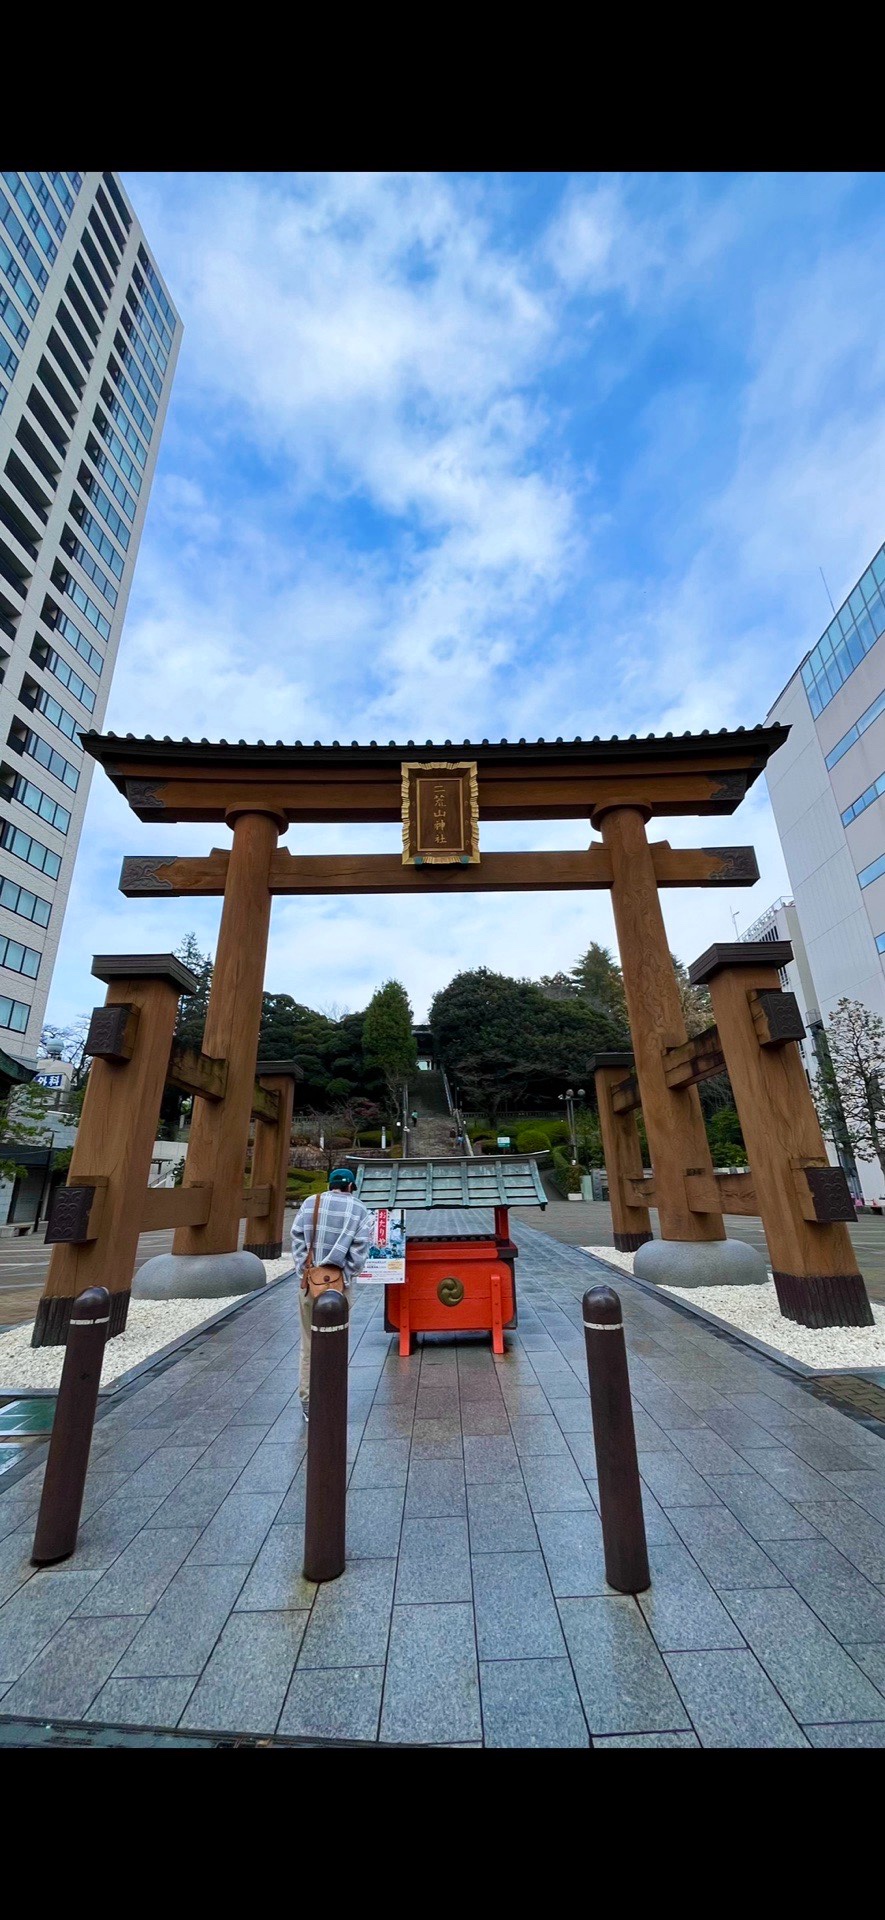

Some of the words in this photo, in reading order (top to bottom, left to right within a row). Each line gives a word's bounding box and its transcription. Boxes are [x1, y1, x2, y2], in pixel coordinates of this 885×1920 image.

[433, 785, 447, 844] 二荒山神社
[378, 1211, 386, 1246] おたりや
